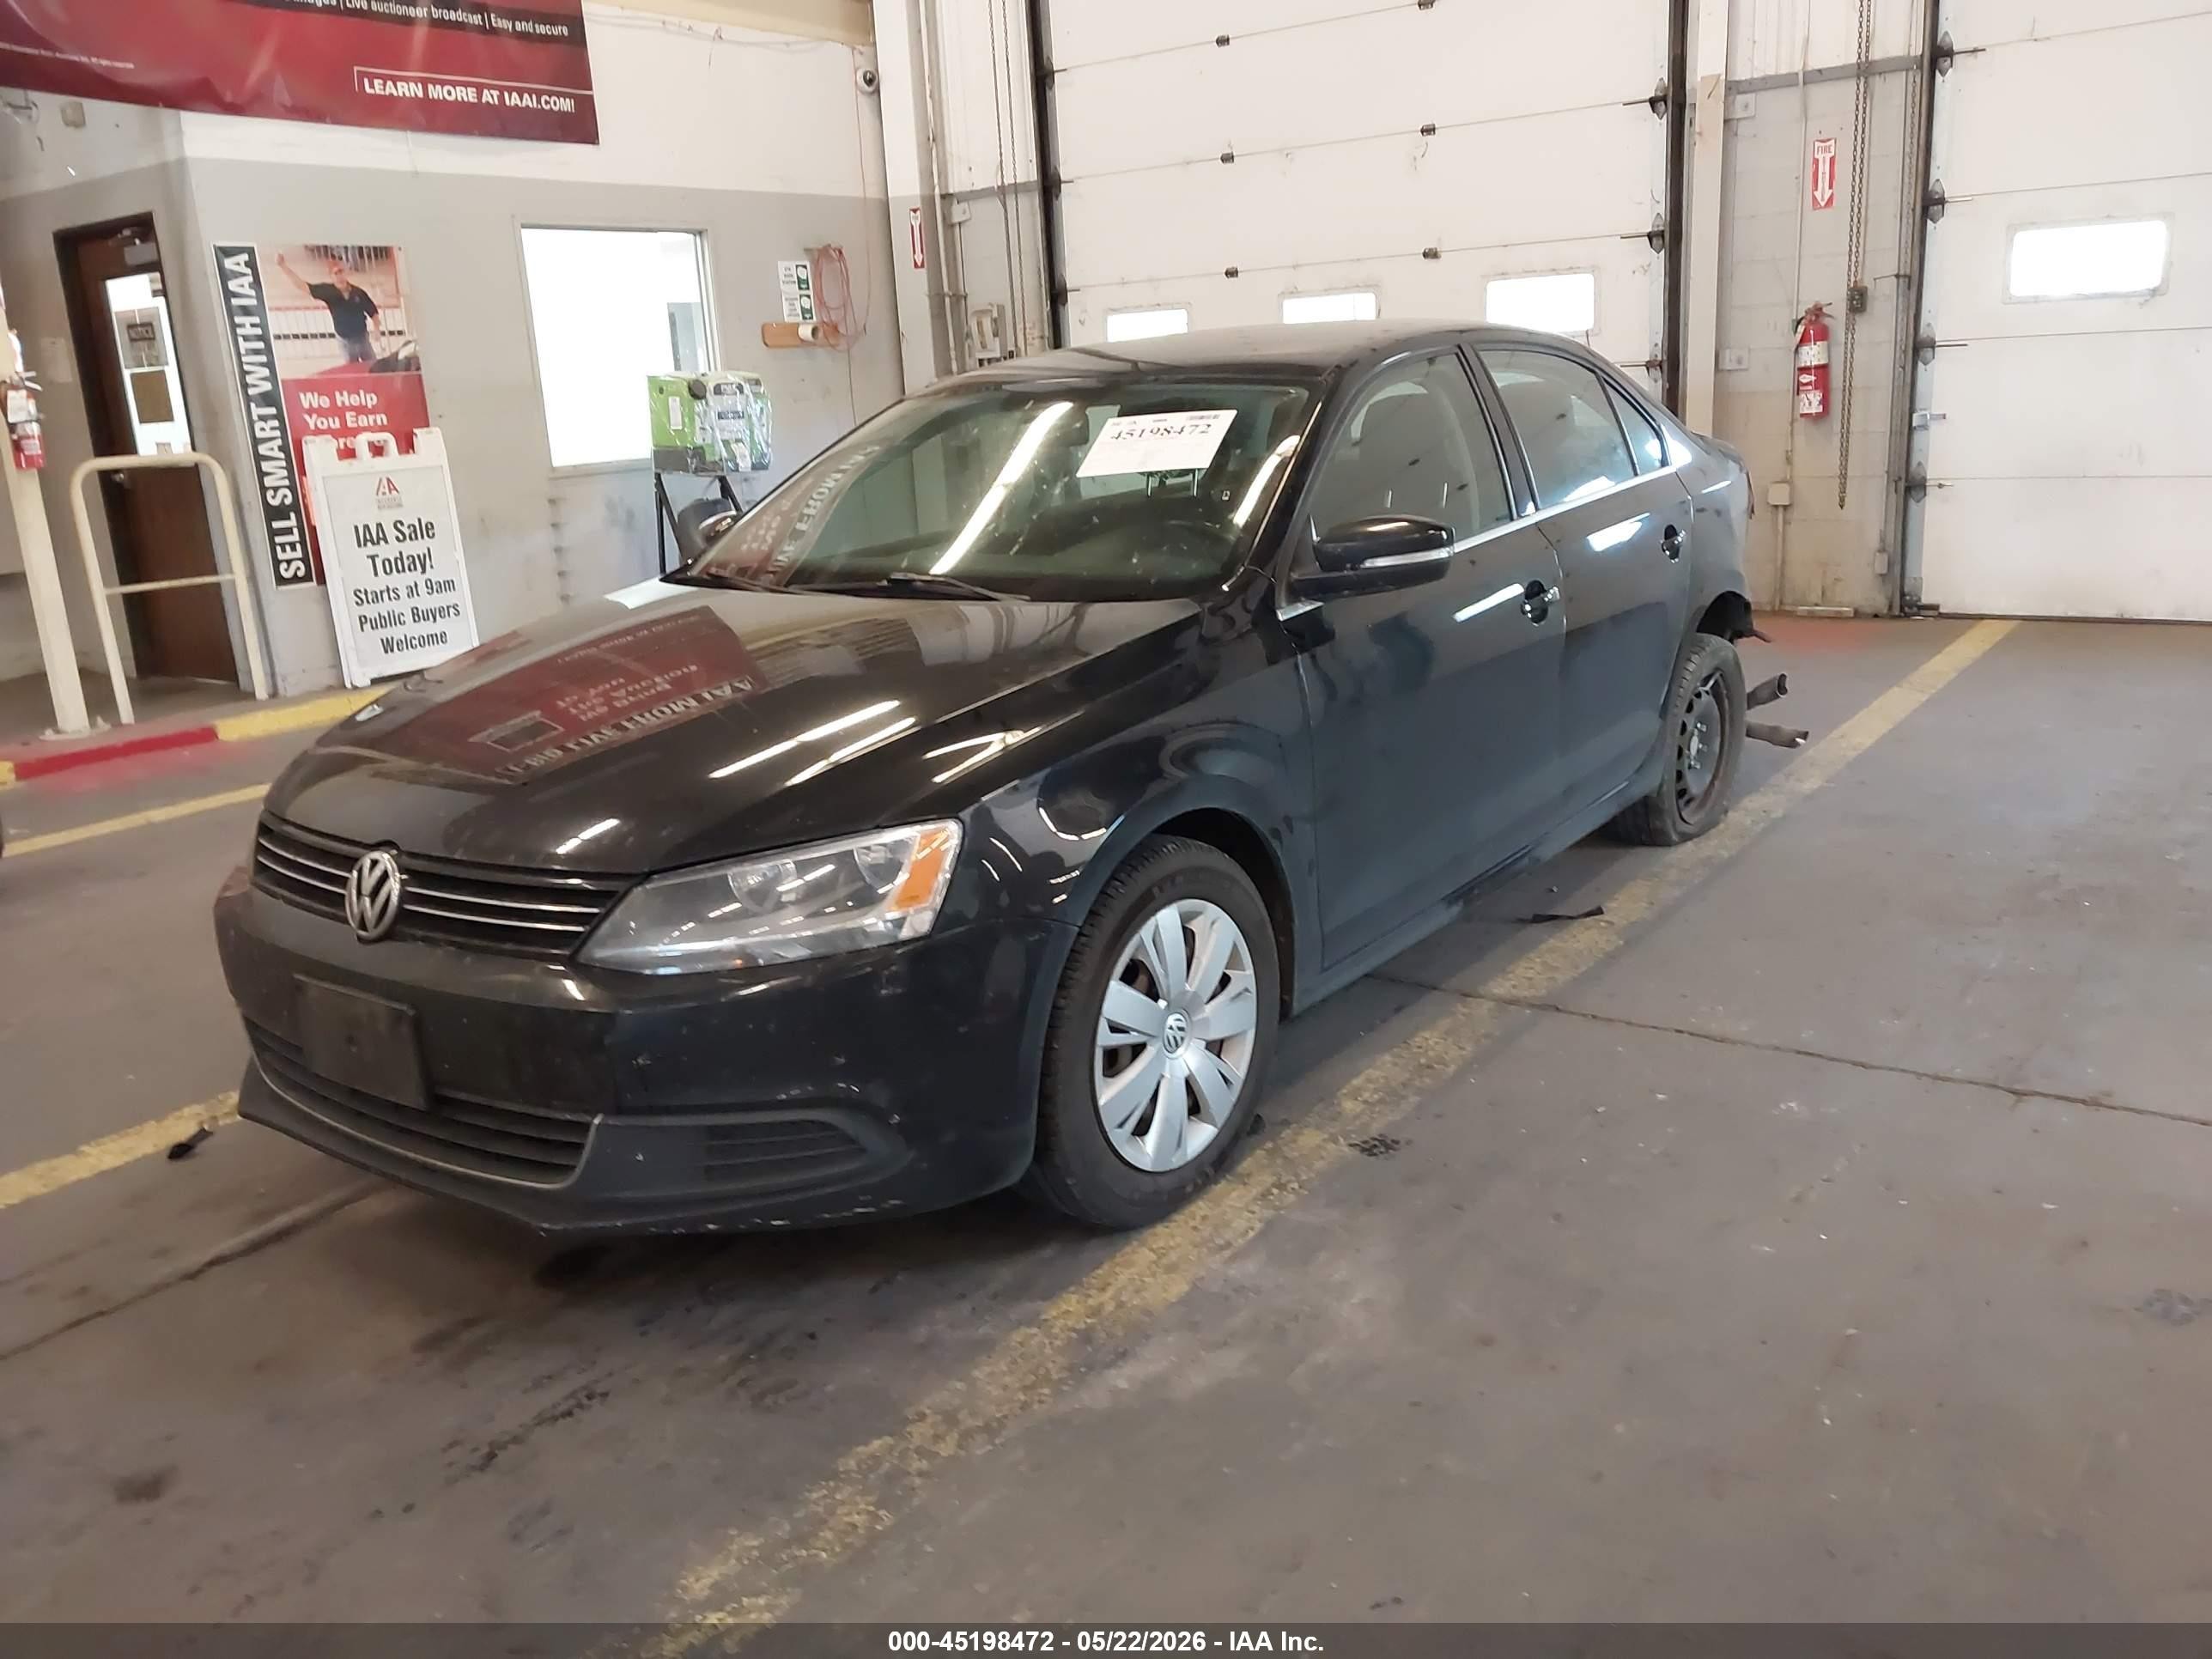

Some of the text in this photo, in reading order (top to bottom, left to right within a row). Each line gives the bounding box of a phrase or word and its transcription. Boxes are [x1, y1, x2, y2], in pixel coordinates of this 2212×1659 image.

[371, 2, 428, 18] auctioneer
[431, 5, 483, 26] broadcast
[490, 13, 514, 32] Easy
[515, 21, 533, 33] and
[535, 24, 569, 36] secure
[363, 77, 575, 112] LEARN MORE AT IAAI.COM!
[1816, 144, 1833, 155] FIRE
[299, 389, 378, 410] We Help
[224, 252, 306, 580] SELL SMART WITH IAA
[303, 411, 388, 430] You Earn
[354, 517, 436, 548] IAA Sale
[367, 546, 434, 578] Today!
[353, 578, 457, 606] Starts at 9am
[358, 603, 461, 632] Public Buyers
[380, 630, 448, 654] Welcome
